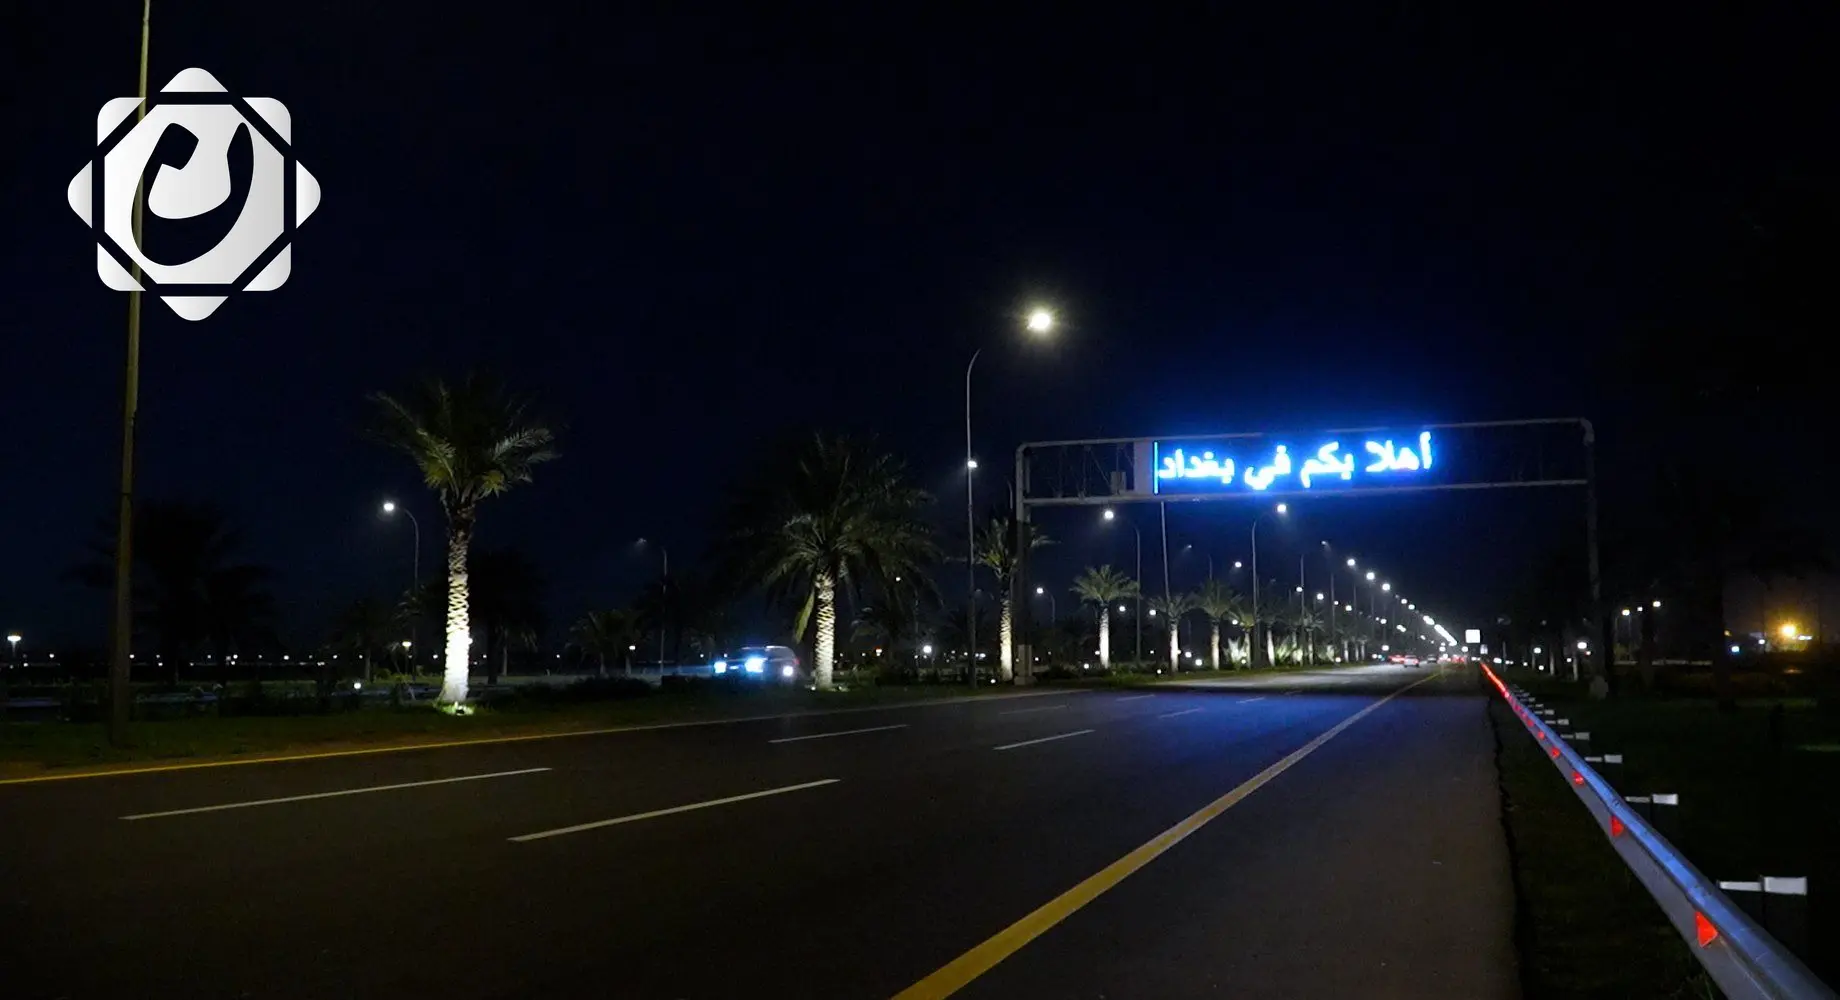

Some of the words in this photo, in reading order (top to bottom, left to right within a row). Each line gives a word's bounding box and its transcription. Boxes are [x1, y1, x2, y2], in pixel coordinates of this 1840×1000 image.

[1159, 448, 1235, 484] بغداد
[1244, 445, 1291, 490] في
[1301, 442, 1354, 488] بكم
[1365, 431, 1432, 472] أهلا
